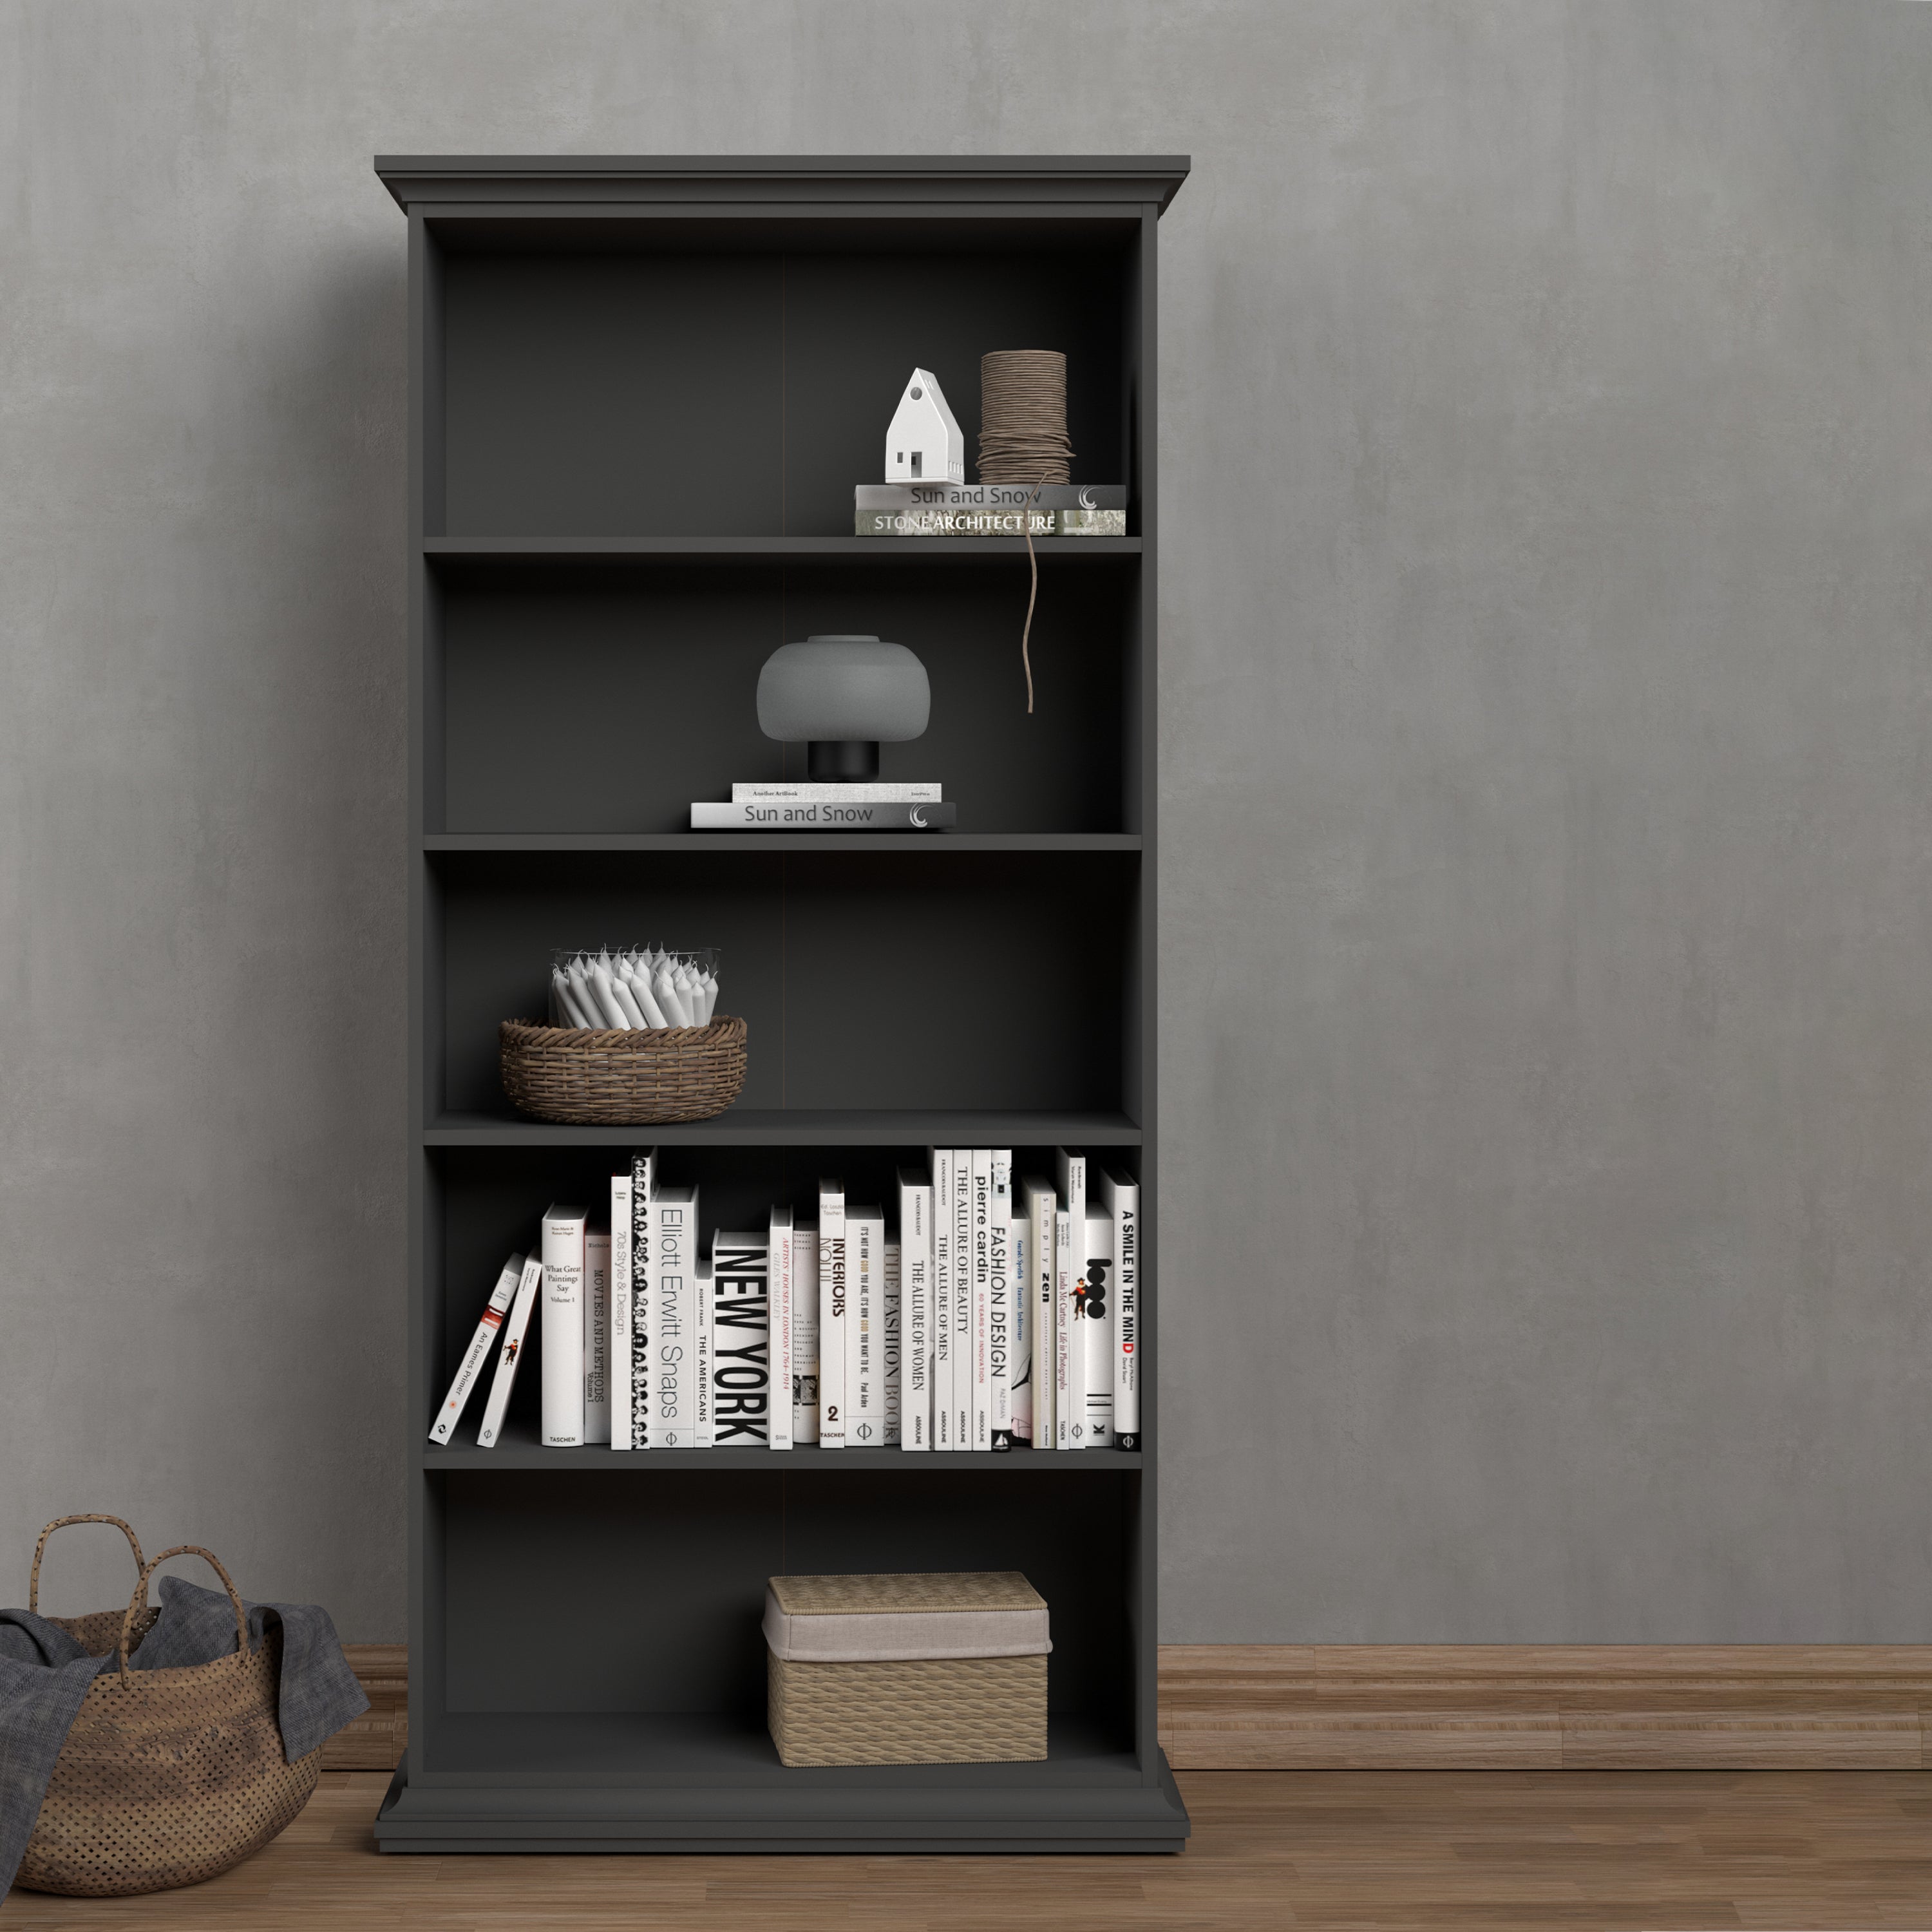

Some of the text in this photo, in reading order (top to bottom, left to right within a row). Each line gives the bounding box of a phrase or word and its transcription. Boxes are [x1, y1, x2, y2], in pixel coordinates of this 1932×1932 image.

[911, 487, 1041, 503] Sun and Snow
[875, 516, 930, 529] STONE
[745, 805, 872, 822] Sun and Snow
[617, 1231, 627, 1249] 70s
[975, 1177, 989, 1282] pierre cardin
[615, 1251, 627, 1280] Style
[886, 1249, 899, 1289] THE
[958, 1167, 967, 1334] THE ALLURE OF BEAUTY
[548, 1274, 578, 1283] Paintings
[557, 1285, 569, 1293] Say
[833, 1238, 844, 1317] INTERIORS
[1059, 1271, 1068, 1289] Linda
[1123, 1211, 1134, 1353] A SMILE IN THE MIND
[615, 1294, 627, 1335] Design
[657, 1209, 683, 1418] Elliott Erwitt Snaps
[783, 1305, 790, 1314] IN
[939, 1235, 947, 1360] THE ALLURE OF MEN
[979, 1293, 984, 1302] 60
[992, 1227, 1006, 1376] FASHION DESIGN
[1057, 1303, 1068, 1327] Cartney
[594, 1269, 605, 1402] MOVIES AND METHODS
[886, 1294, 899, 1379] FASHION
[913, 1260, 924, 1390] THE ALLURE OF WOMEN
[979, 1329, 984, 1338] OF
[1059, 1332, 1068, 1343] Life
[455, 1332, 488, 1396] An Eames Primer
[714, 1249, 768, 1442] NEW YORK
[1057, 1353, 1068, 1390] Photographs
[828, 1406, 838, 1421] 2
